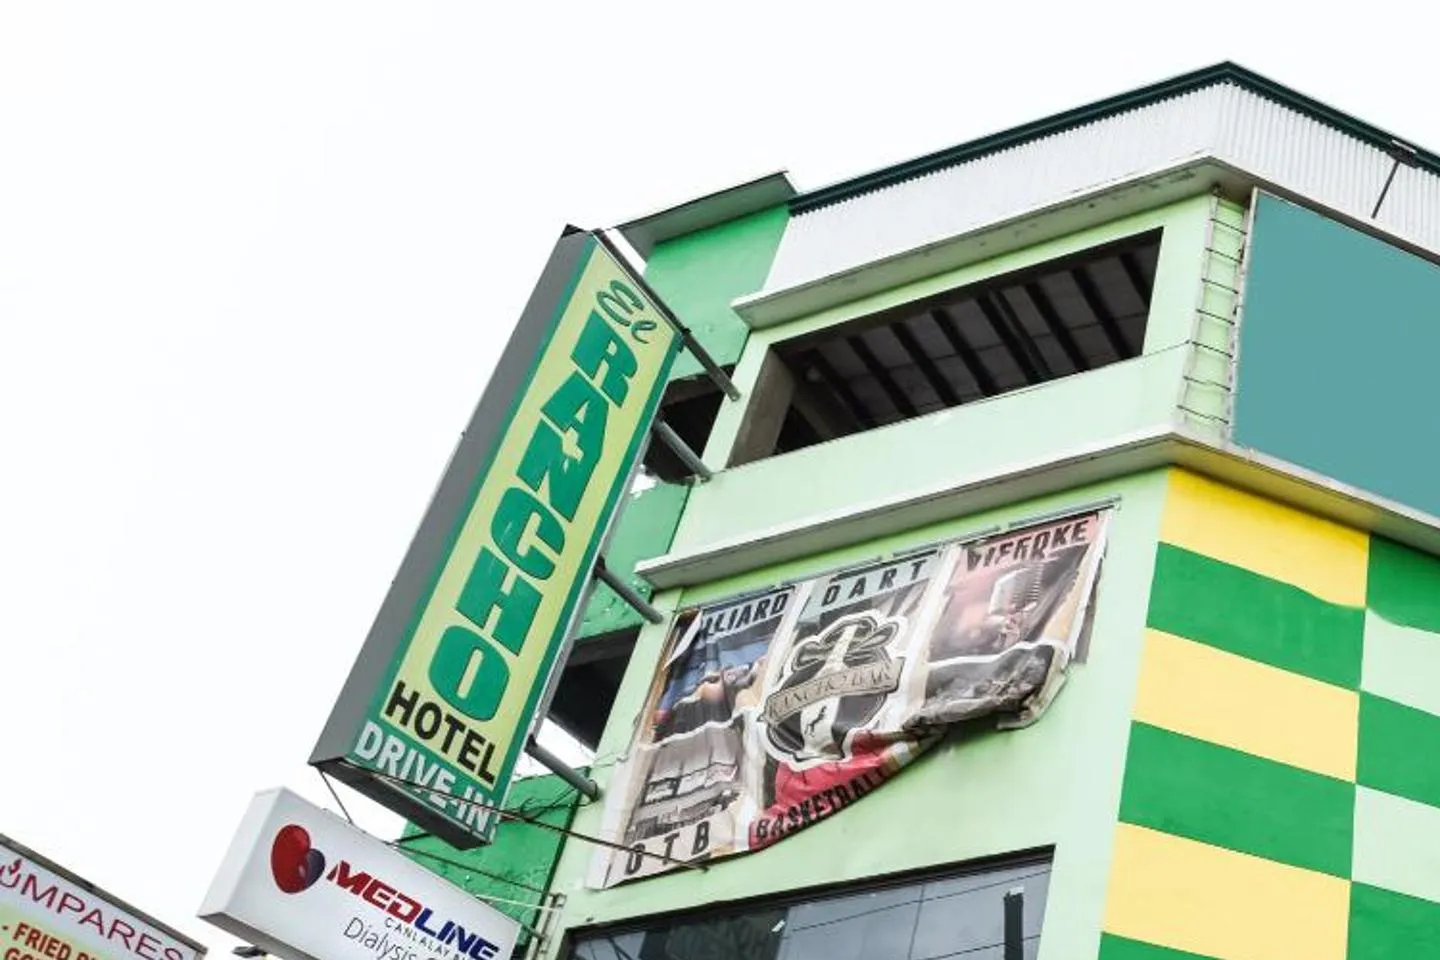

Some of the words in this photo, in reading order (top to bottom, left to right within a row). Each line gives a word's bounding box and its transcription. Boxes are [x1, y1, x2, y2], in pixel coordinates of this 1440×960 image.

[596, 280, 657, 344] El
[821, 558, 927, 606] DART
[385, 679, 496, 785] HOTEL
[354, 719, 495, 833] DRIVE-IN
